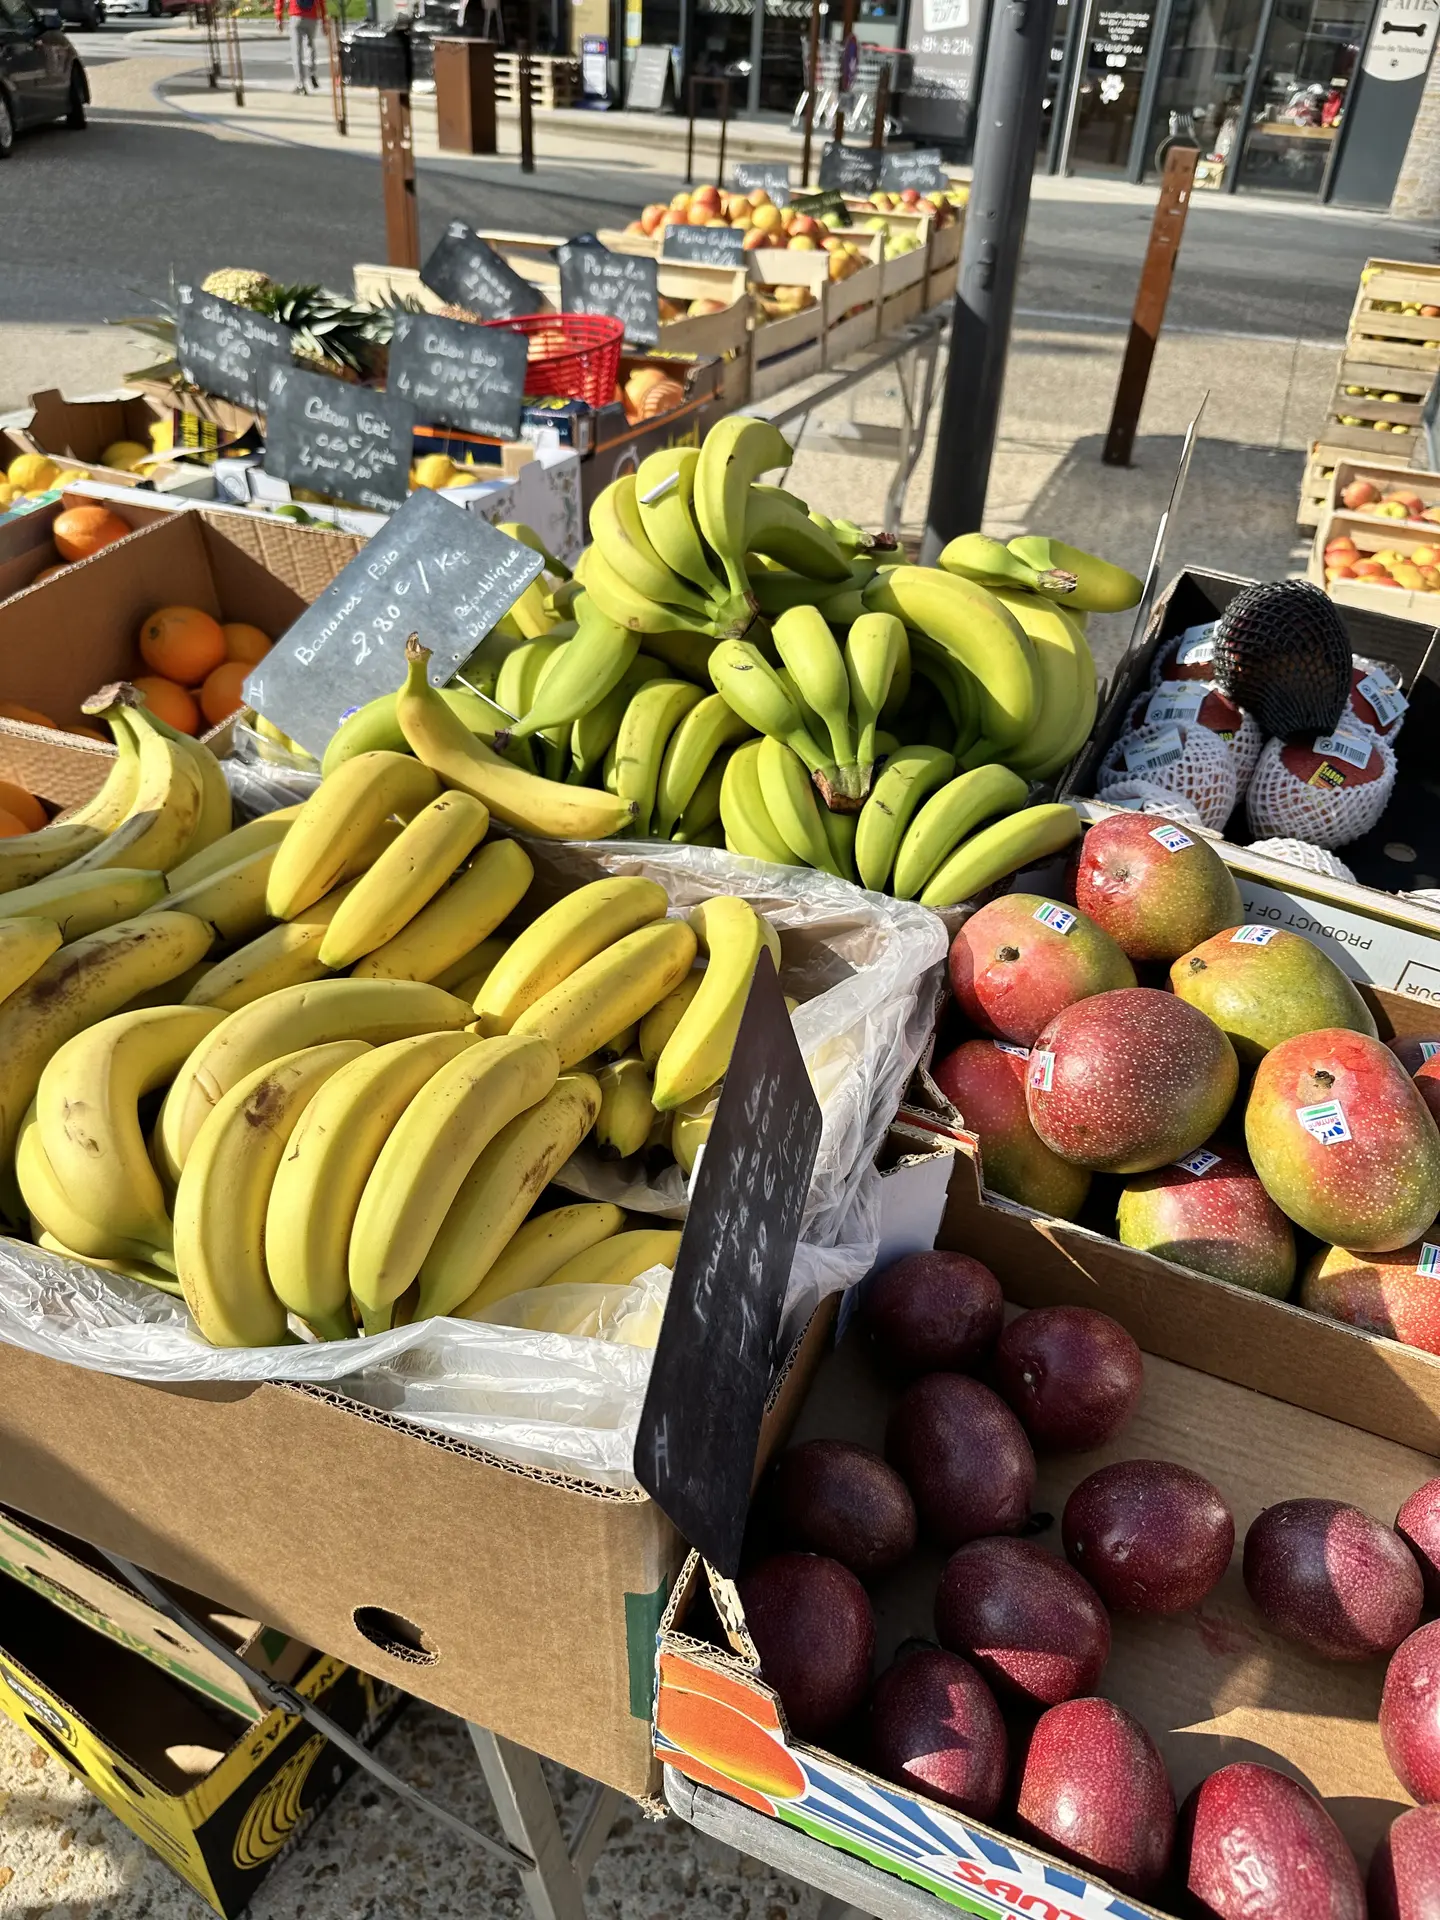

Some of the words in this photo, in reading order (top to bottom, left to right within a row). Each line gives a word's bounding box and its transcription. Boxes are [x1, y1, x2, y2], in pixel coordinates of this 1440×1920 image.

[367, 549, 400, 581] Bio
[454, 549, 520, 621] République
[1256, 907, 1282, 921] OF
[1285, 914, 1374, 950] PRODUCT
